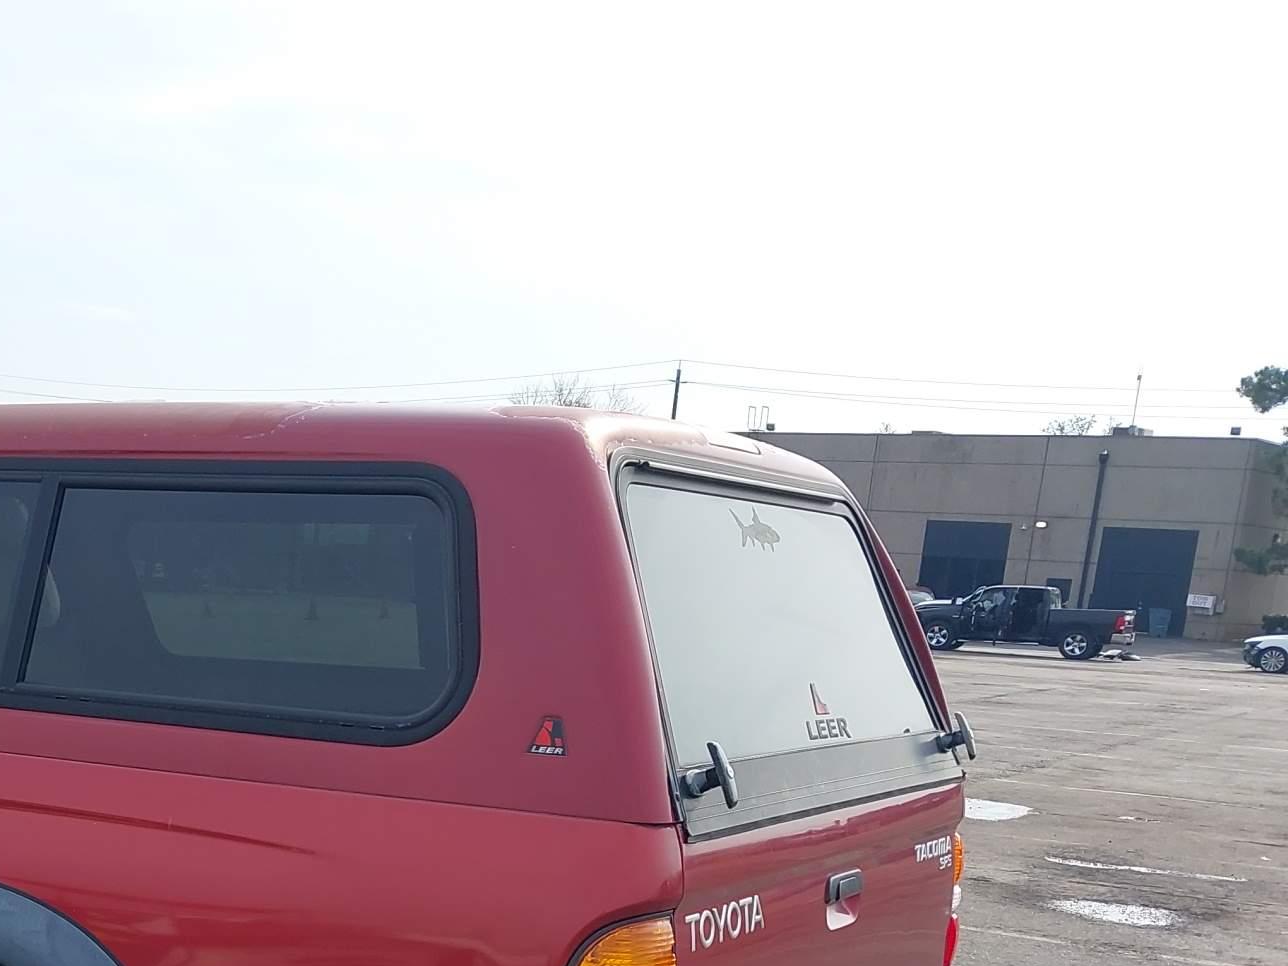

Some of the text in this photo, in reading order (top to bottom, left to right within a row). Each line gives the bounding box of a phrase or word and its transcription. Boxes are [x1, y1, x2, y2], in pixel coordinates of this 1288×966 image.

[806, 717, 852, 741] LEER
[530, 745, 564, 755] LEER
[914, 835, 952, 863] TACOMA
[685, 894, 765, 953] TOYOTA
